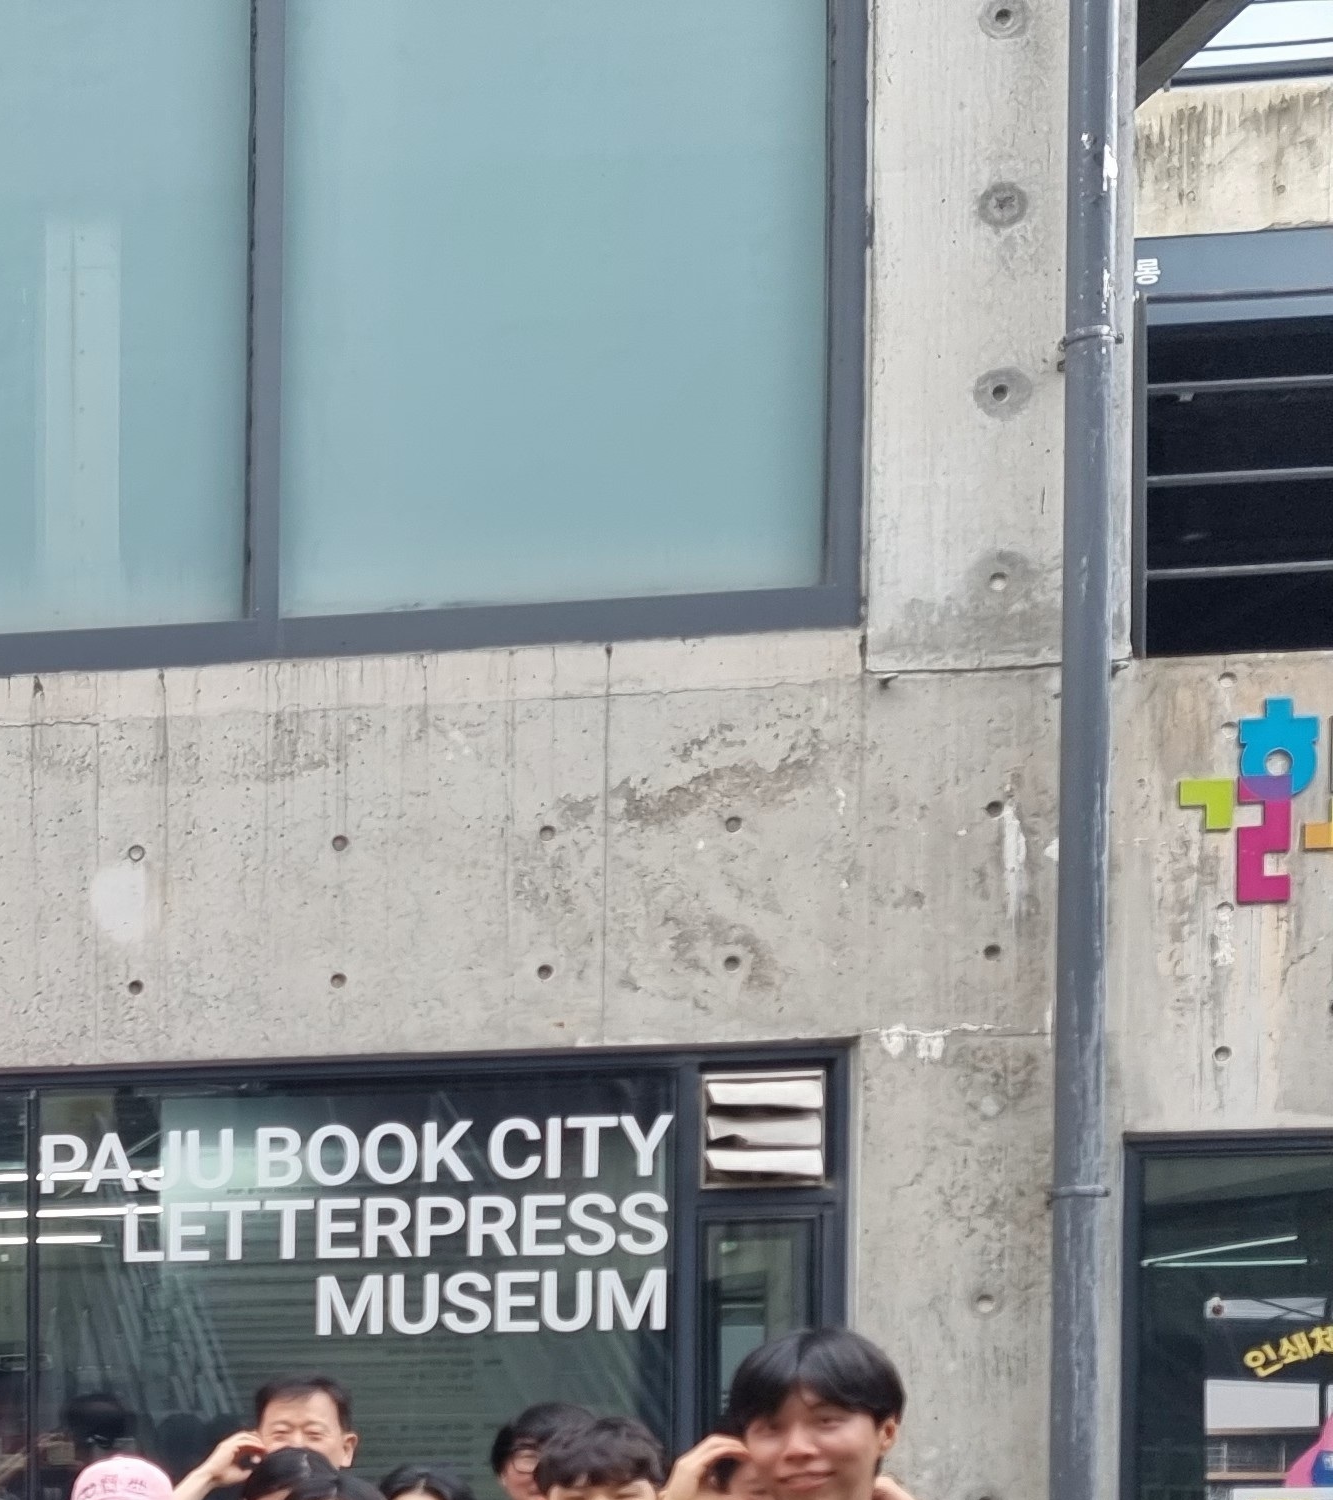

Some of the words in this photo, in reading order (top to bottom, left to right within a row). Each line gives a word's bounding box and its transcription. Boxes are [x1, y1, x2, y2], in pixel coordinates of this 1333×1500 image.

[40, 1128, 233, 1194] PAJU
[255, 1119, 473, 1188] BOOK
[489, 1113, 674, 1180] CITY
[123, 1192, 668, 1262] LETTERPRESS
[316, 1267, 667, 1336] MUSEUM
